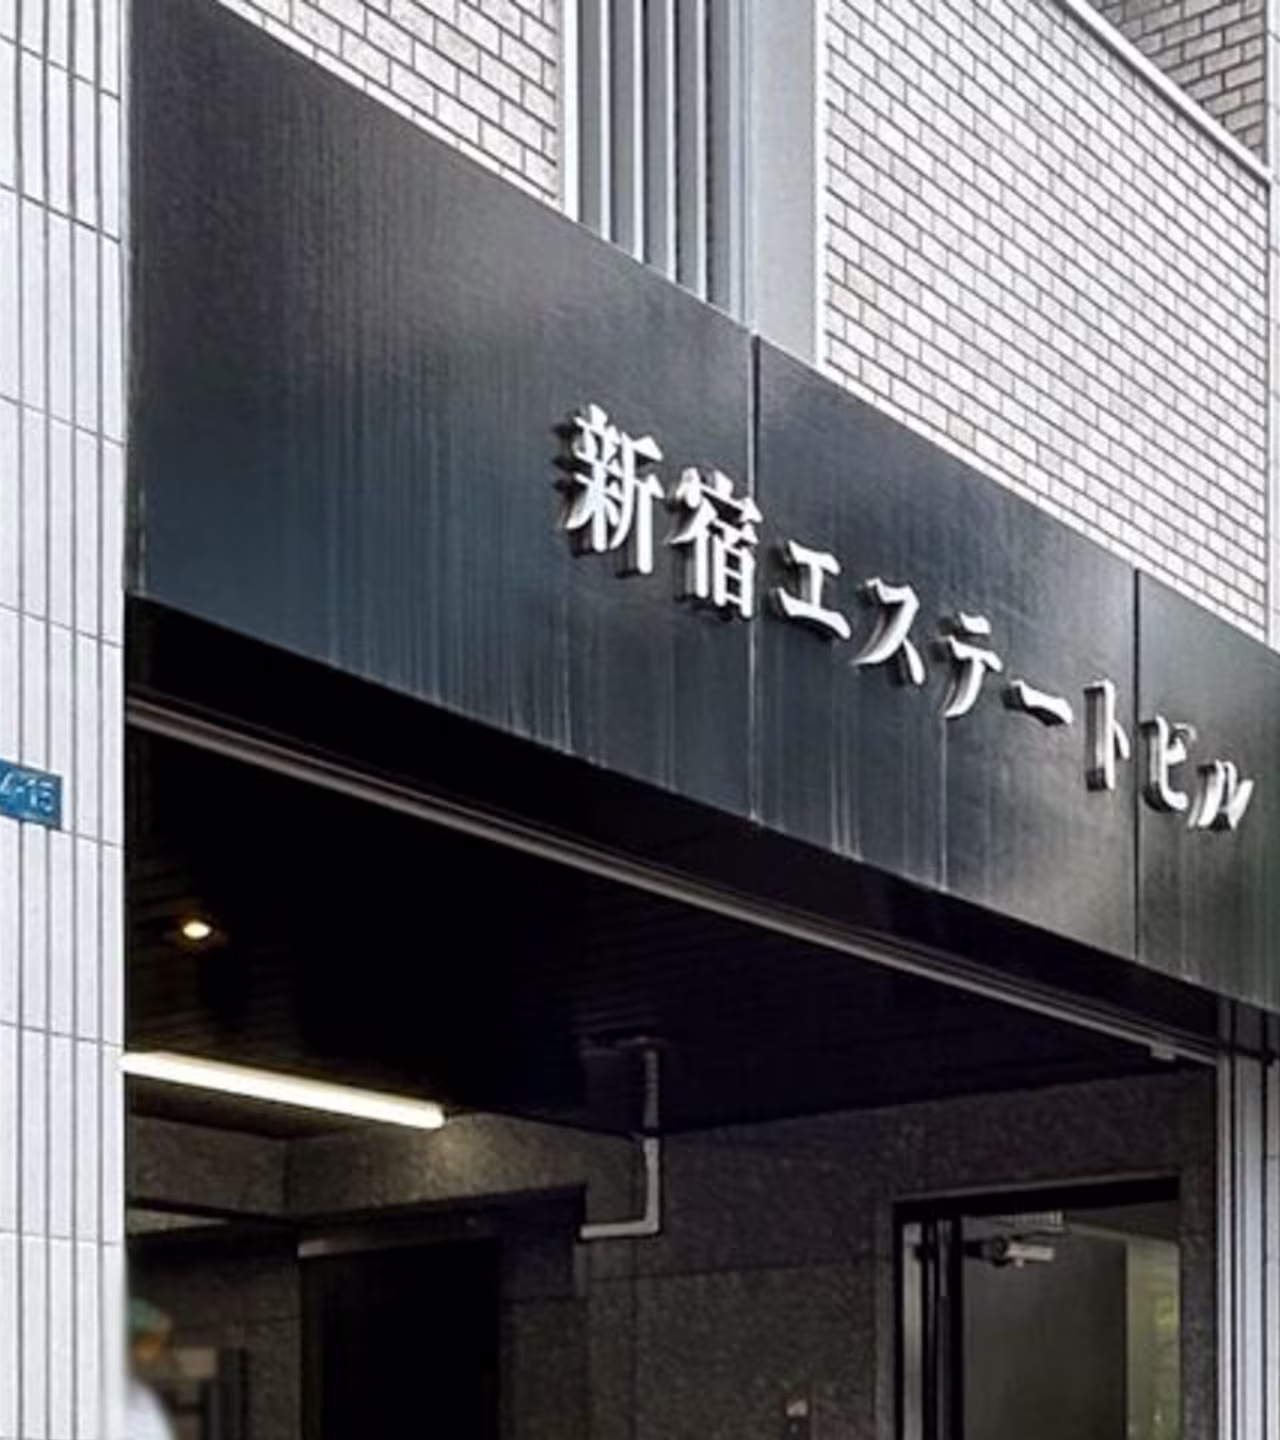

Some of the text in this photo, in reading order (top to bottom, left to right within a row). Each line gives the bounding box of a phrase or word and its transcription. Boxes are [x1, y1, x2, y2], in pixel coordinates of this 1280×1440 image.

[562, 403, 1254, 831] 新宿エステートビル
